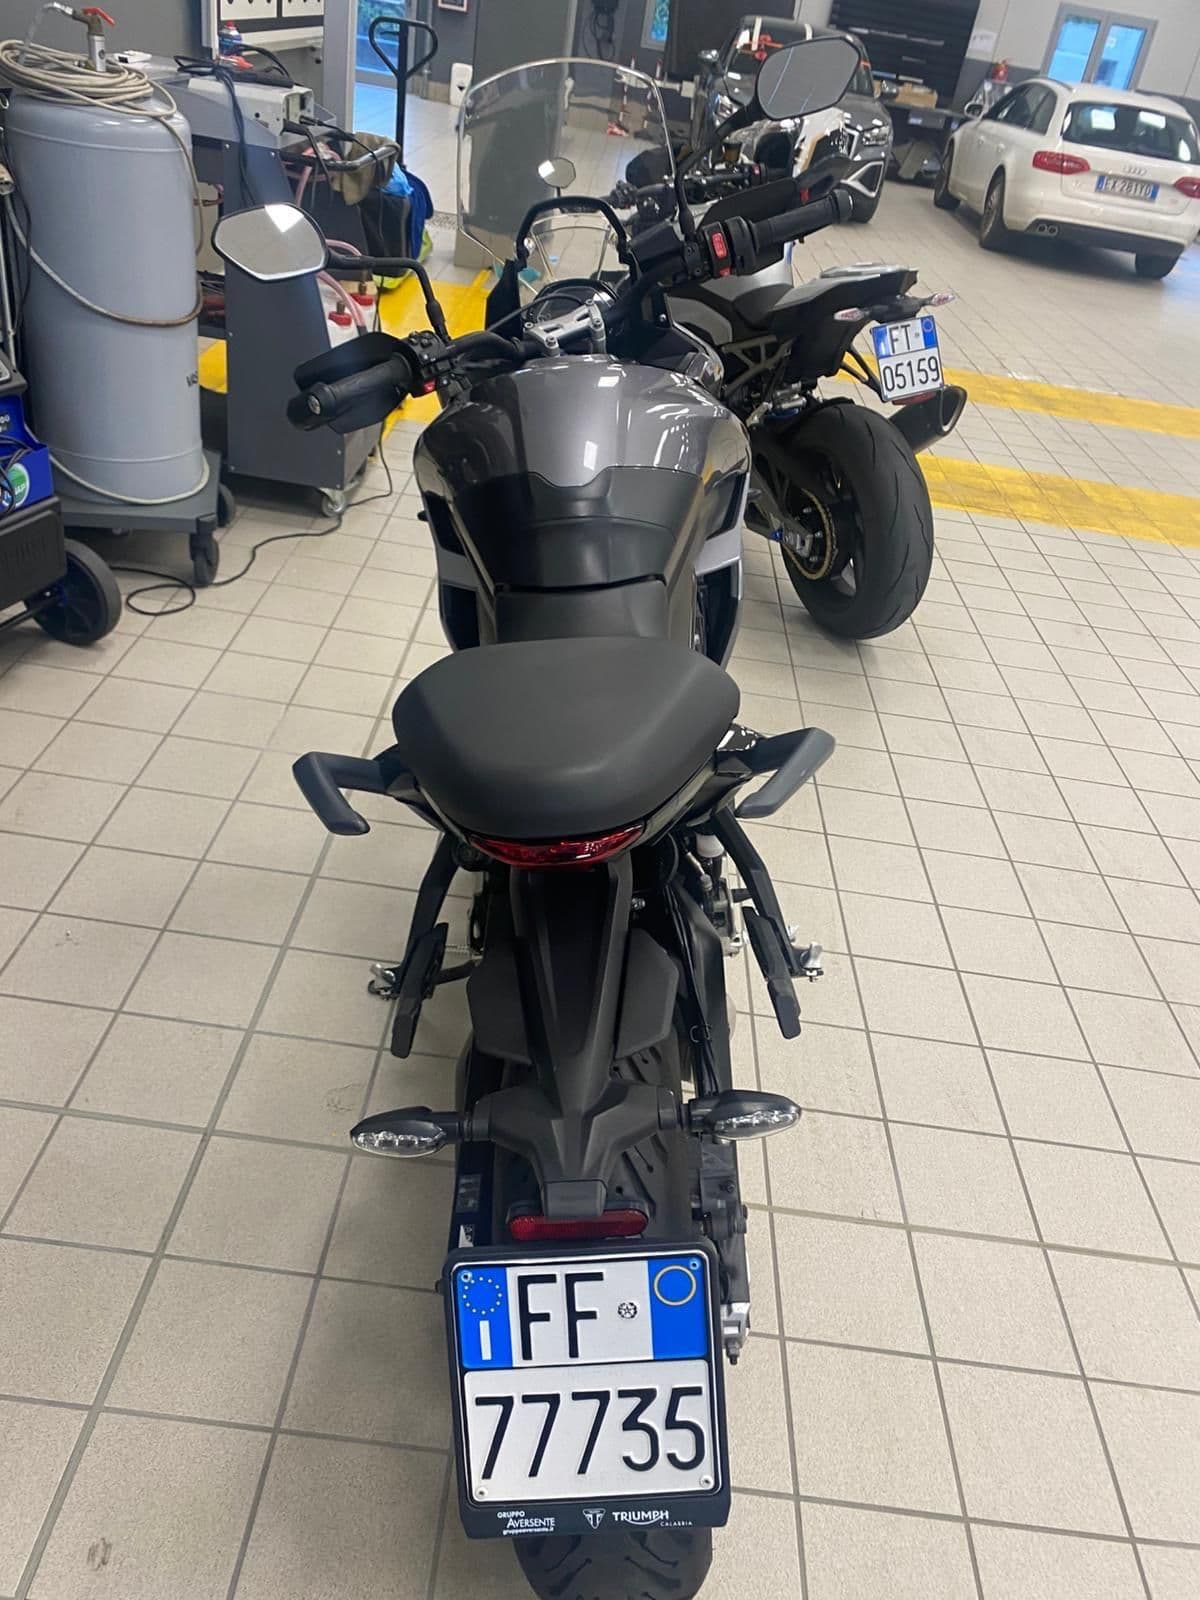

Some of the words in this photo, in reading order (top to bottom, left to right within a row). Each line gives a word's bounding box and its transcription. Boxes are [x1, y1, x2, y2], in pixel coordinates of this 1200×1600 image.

[889, 324, 910, 353] FT
[883, 356, 940, 392] 05159
[479, 1320, 492, 1360] I
[517, 1271, 604, 1361] FF
[475, 1386, 705, 1480] 77735
[497, 1510, 525, 1519] GRUPPO
[506, 1517, 555, 1529] AVERSENTE
[612, 1510, 669, 1522] TRIUMPH
